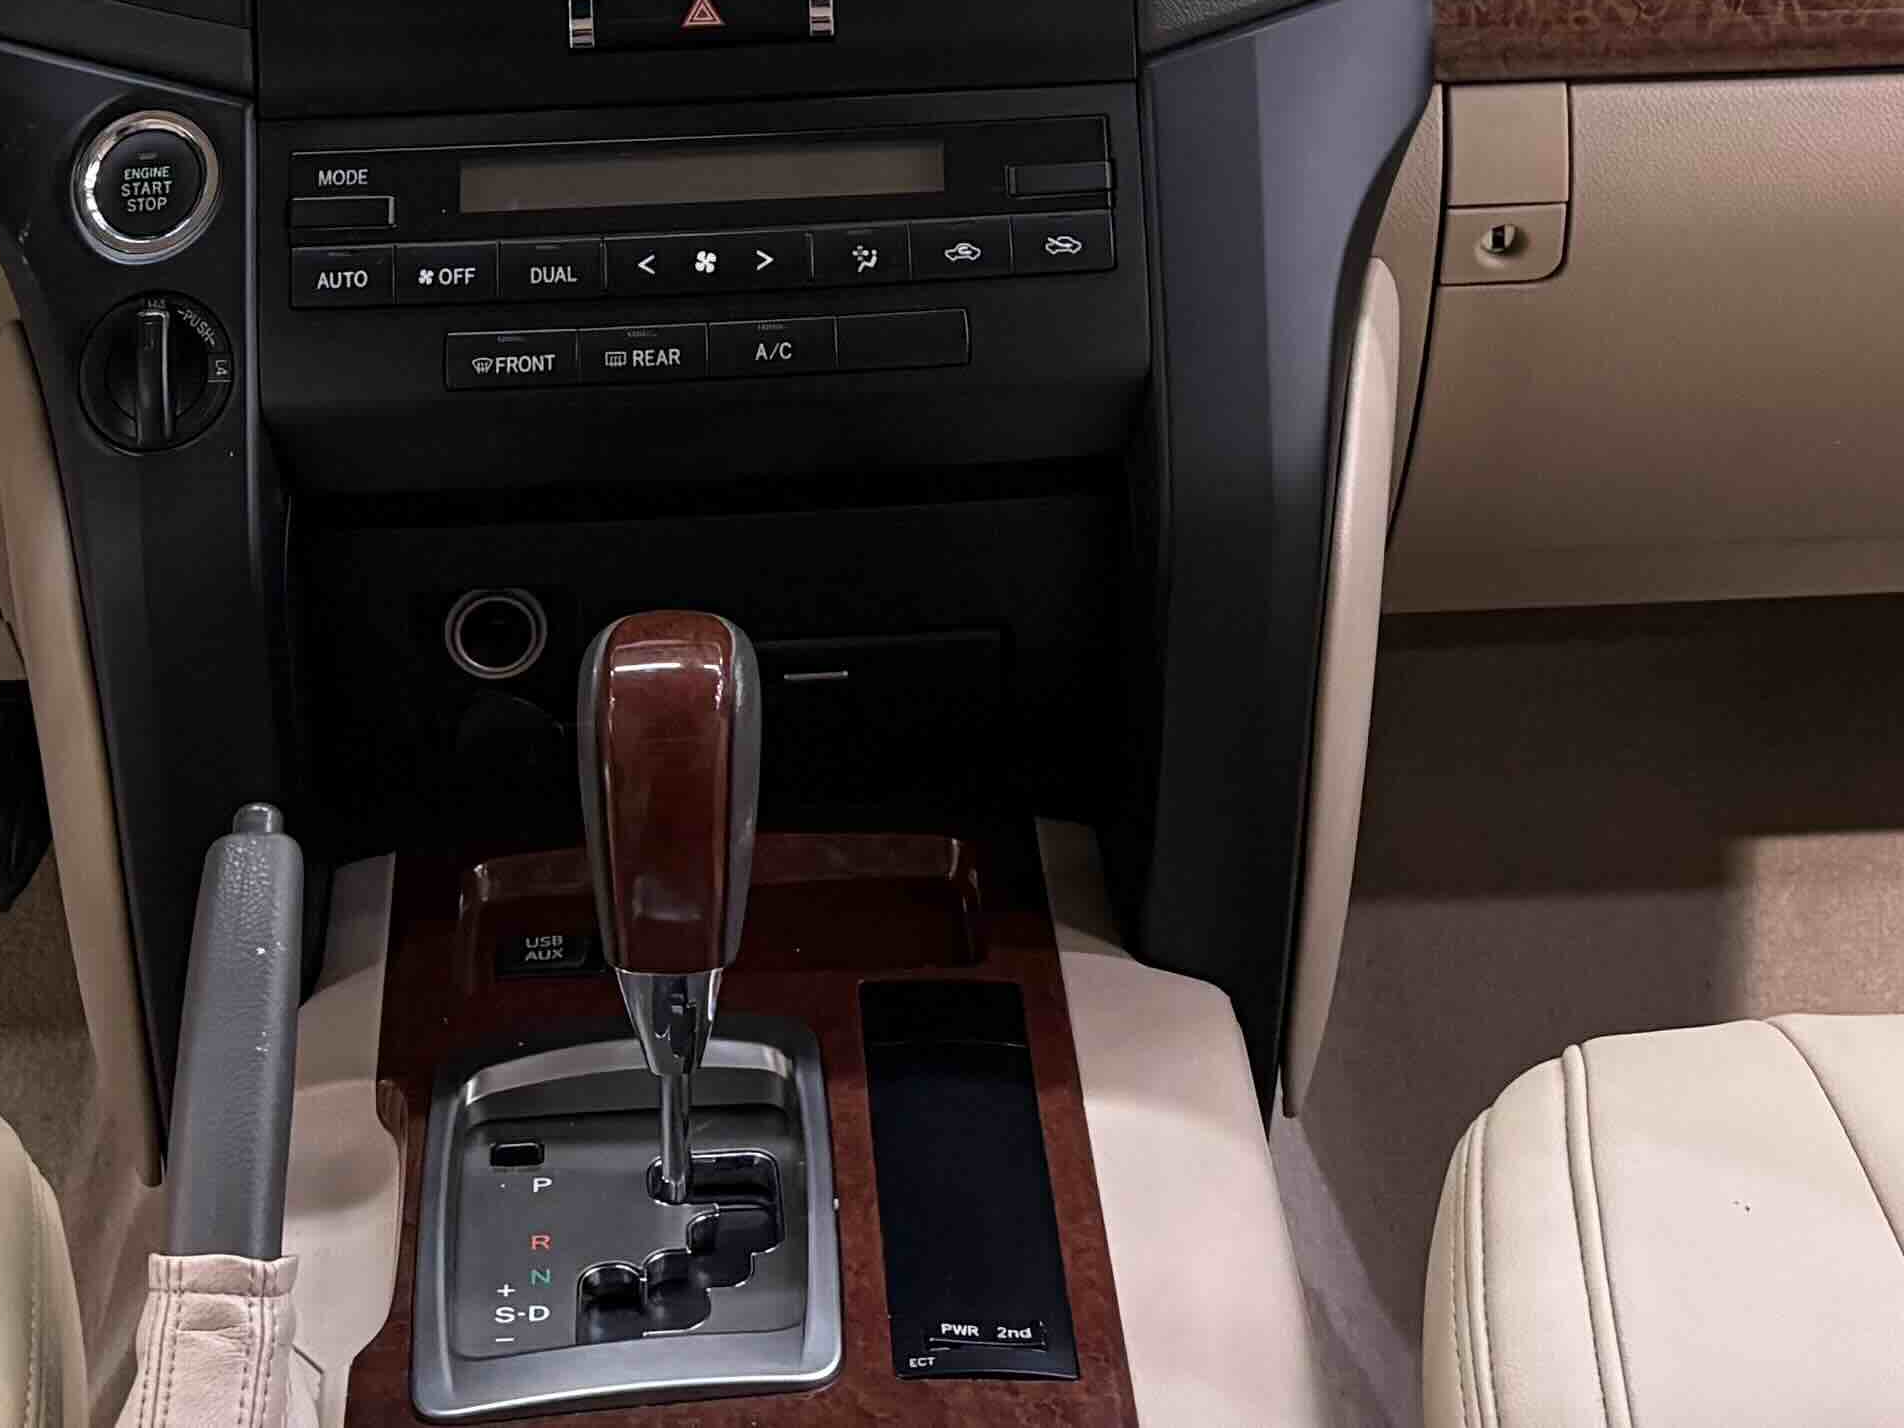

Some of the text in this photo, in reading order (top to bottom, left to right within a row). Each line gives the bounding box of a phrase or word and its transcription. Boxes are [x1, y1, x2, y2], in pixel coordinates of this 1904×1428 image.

[124, 166, 170, 180] ENGINE
[318, 169, 368, 187] MODE
[121, 181, 173, 197] START
[127, 197, 167, 212] STOP
[317, 270, 368, 289] AUTO
[439, 268, 476, 286] OFF
[530, 266, 577, 285] DUAL
[632, 349, 681, 367] REAR
[755, 342, 793, 361] A/C
[496, 354, 556, 374] FRONT
[525, 935, 564, 948] USB
[524, 948, 564, 961] AUX
[532, 1177, 553, 1193] P
[530, 1235, 552, 1250] R
[530, 1269, 552, 1285] N
[940, 1323, 1033, 1339] PWR 2nd
[909, 1357, 936, 1368] ECT
